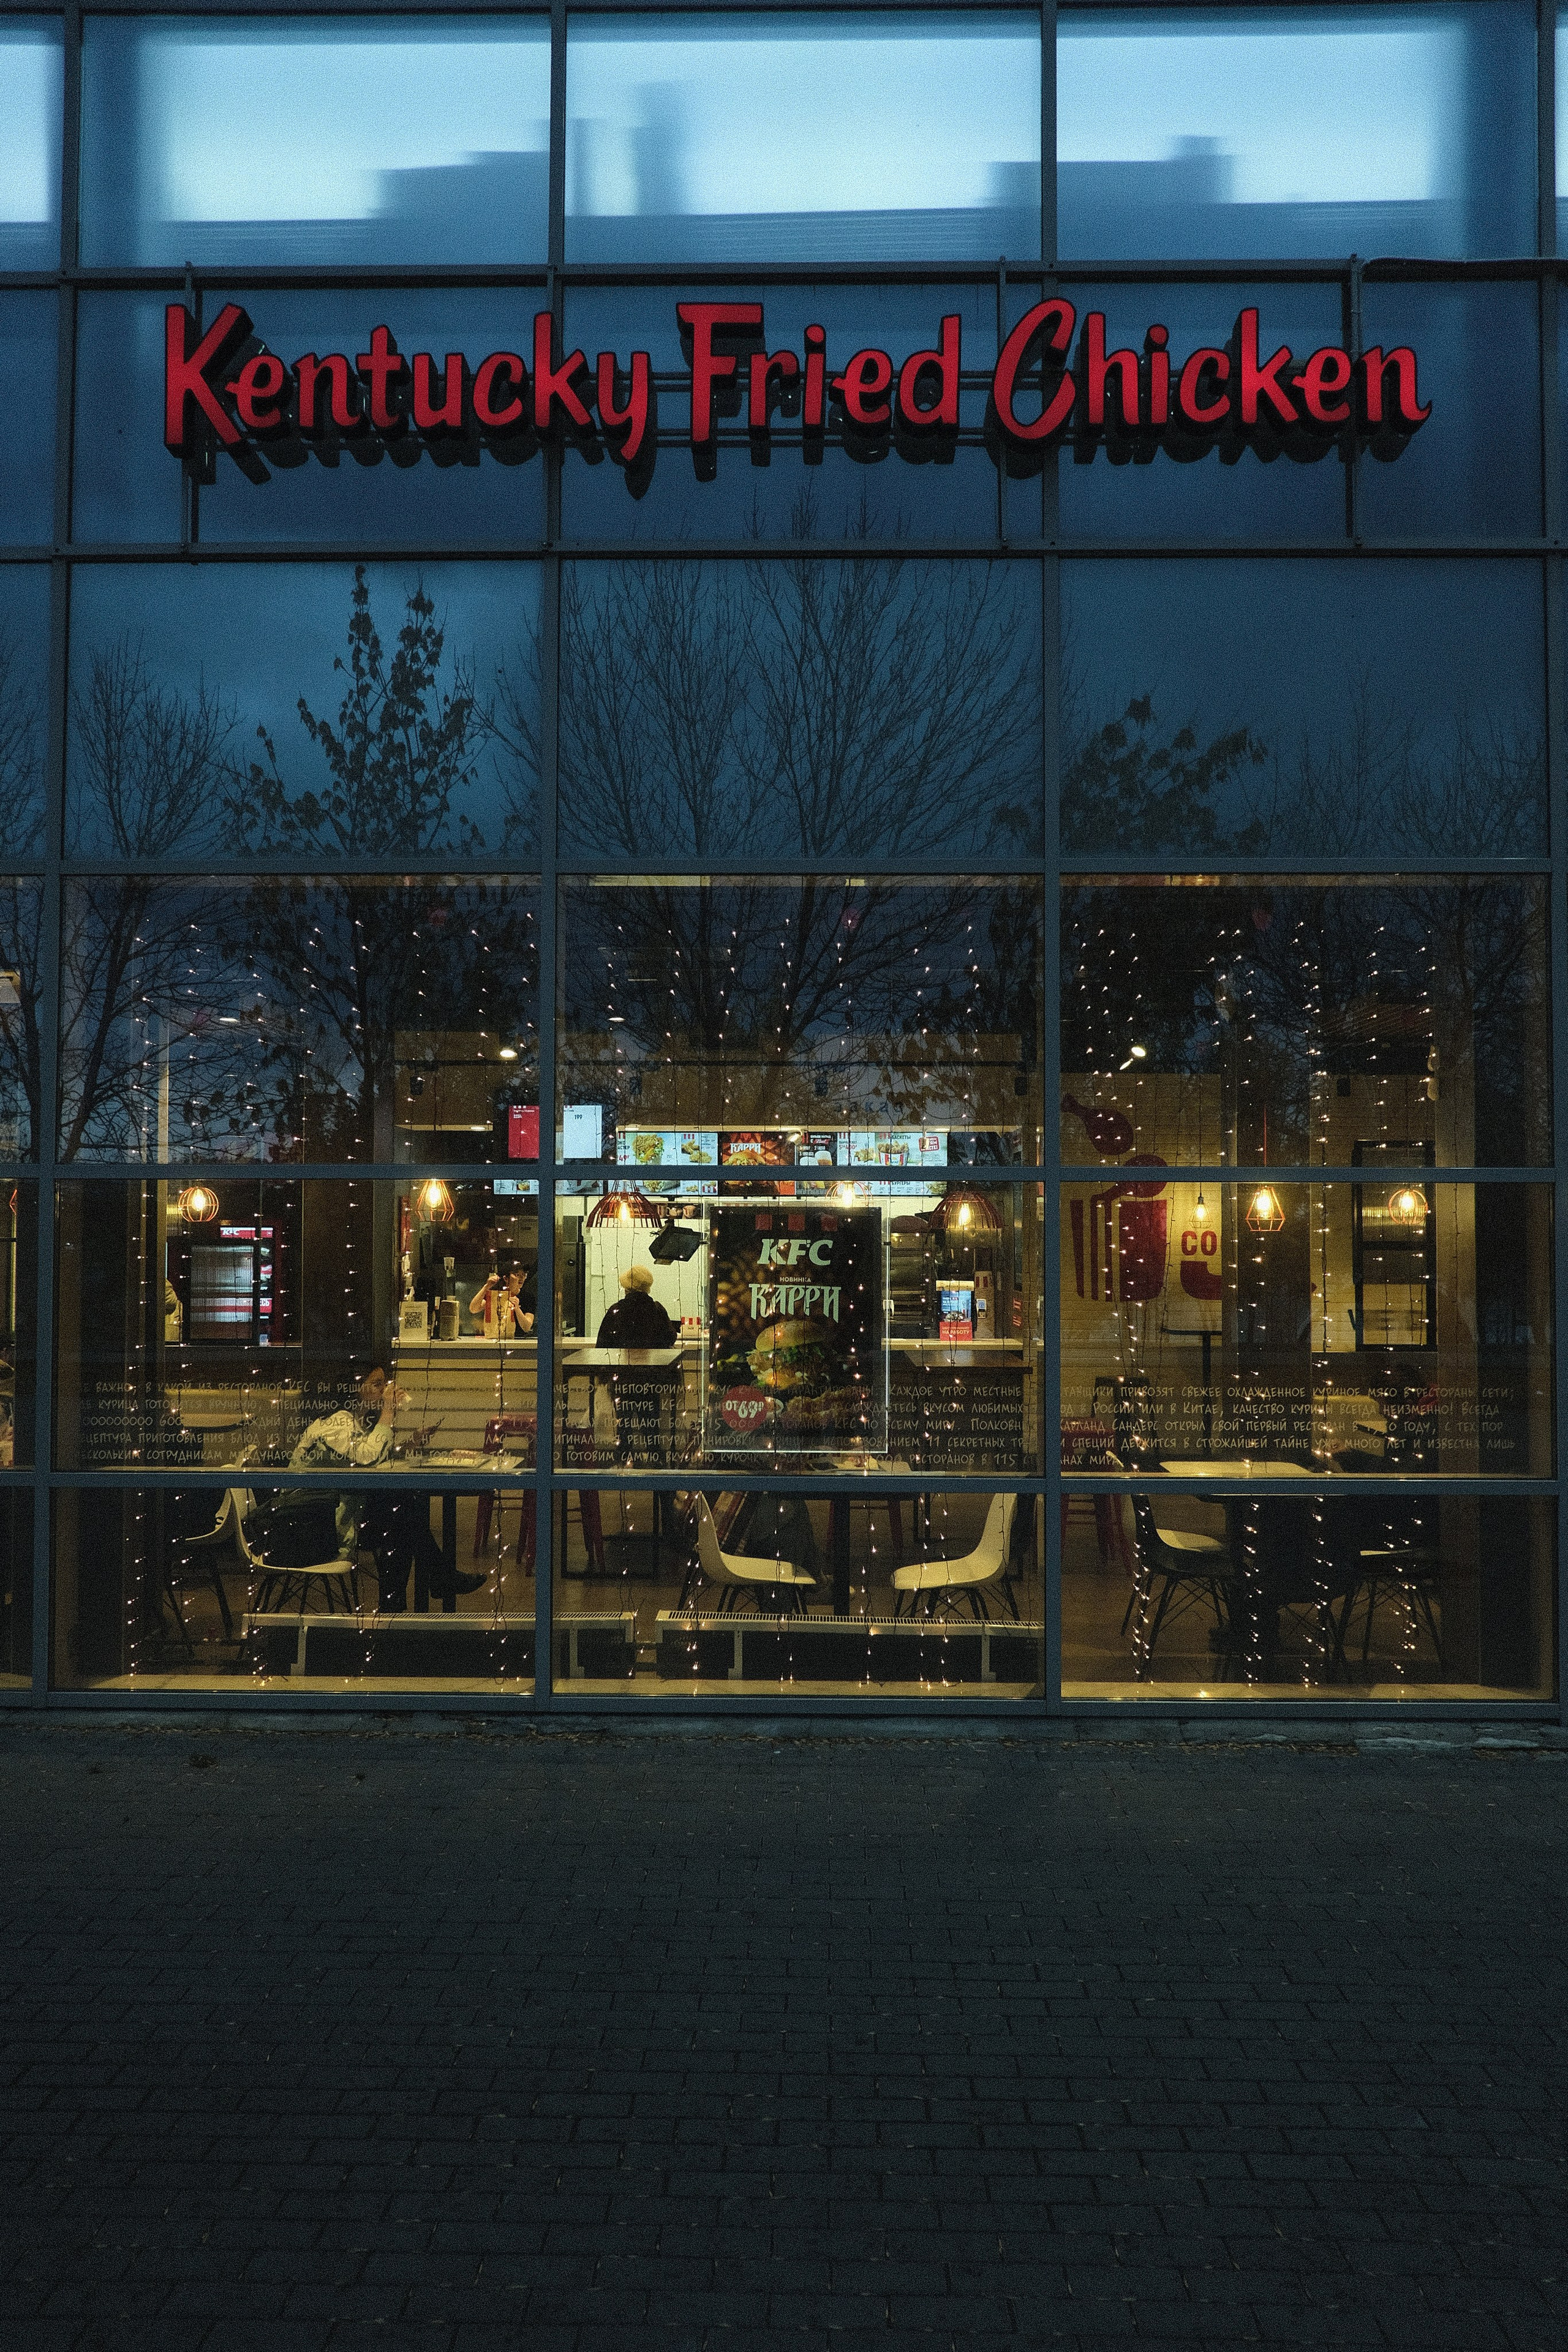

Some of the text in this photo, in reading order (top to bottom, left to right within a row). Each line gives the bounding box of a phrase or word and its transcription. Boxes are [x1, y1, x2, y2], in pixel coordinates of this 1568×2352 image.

[165, 298, 1432, 462] Kentucky Fried Chicken
[757, 1238, 834, 1266] KFC
[748, 1283, 842, 1324] КАРРИ
[317, 1382, 331, 1393] ВЫ
[889, 1384, 934, 1398] КАЖДОЕ
[939, 1385, 967, 1397] УТРО
[973, 1385, 1022, 1397] МЕСТНЫЕ
[1120, 1385, 1174, 1397] ПРИВОЗЯТ
[1181, 1386, 1223, 1398] СВЕЖЕЕ
[1227, 1387, 1306, 1400] ОХЛАЖДЕННОЕ
[98, 1399, 139, 1411] КУРИЦА
[725, 1400, 739, 1412] ОТ
[922, 1401, 965, 1414] ВКУСОМ
[971, 1402, 1023, 1414] ЛЮБИМЫХ
[1170, 1403, 1177, 1415] В
[1183, 1401, 1223, 1417] КИТАЕ,
[1232, 1403, 1285, 1415] КАЧЕСТВО
[1340, 1403, 1377, 1418] ВСЕГДА
[1383, 1402, 1453, 1416] НЕИЗМЕННО!
[1461, 1400, 1500, 1419] ВСЕГДА
[834, 1417, 858, 1430] KFC
[1112, 1418, 1158, 1434] САНДЕРС
[1164, 1420, 1205, 1431] ОТКРЫЛ
[1212, 1417, 1239, 1432] СВОЙ
[1246, 1417, 1286, 1432] ПЕРВЫЙ
[1403, 1421, 1436, 1435] ГОДУ,
[1482, 1421, 1504, 1432] ПОР
[927, 1436, 940, 1447] 11
[947, 1436, 1005, 1448] СЕКРЕТНЫХ
[1072, 1435, 1115, 1451] СПЕЦИЙ
[1183, 1437, 1189, 1449] В
[1196, 1434, 1268, 1449] СТРОЖАЙШЕЙ
[1274, 1435, 1309, 1449] ТАЙНЕ
[1344, 1438, 1381, 1449] МНОГО
[1414, 1439, 1420, 1449] И
[1486, 1439, 1516, 1449] ЛИШЬ
[146, 1450, 223, 1463] СОТРУДНИКАМ
[566, 1450, 615, 1462] ГОТОВИМ
[993, 1453, 1018, 1466] 115
